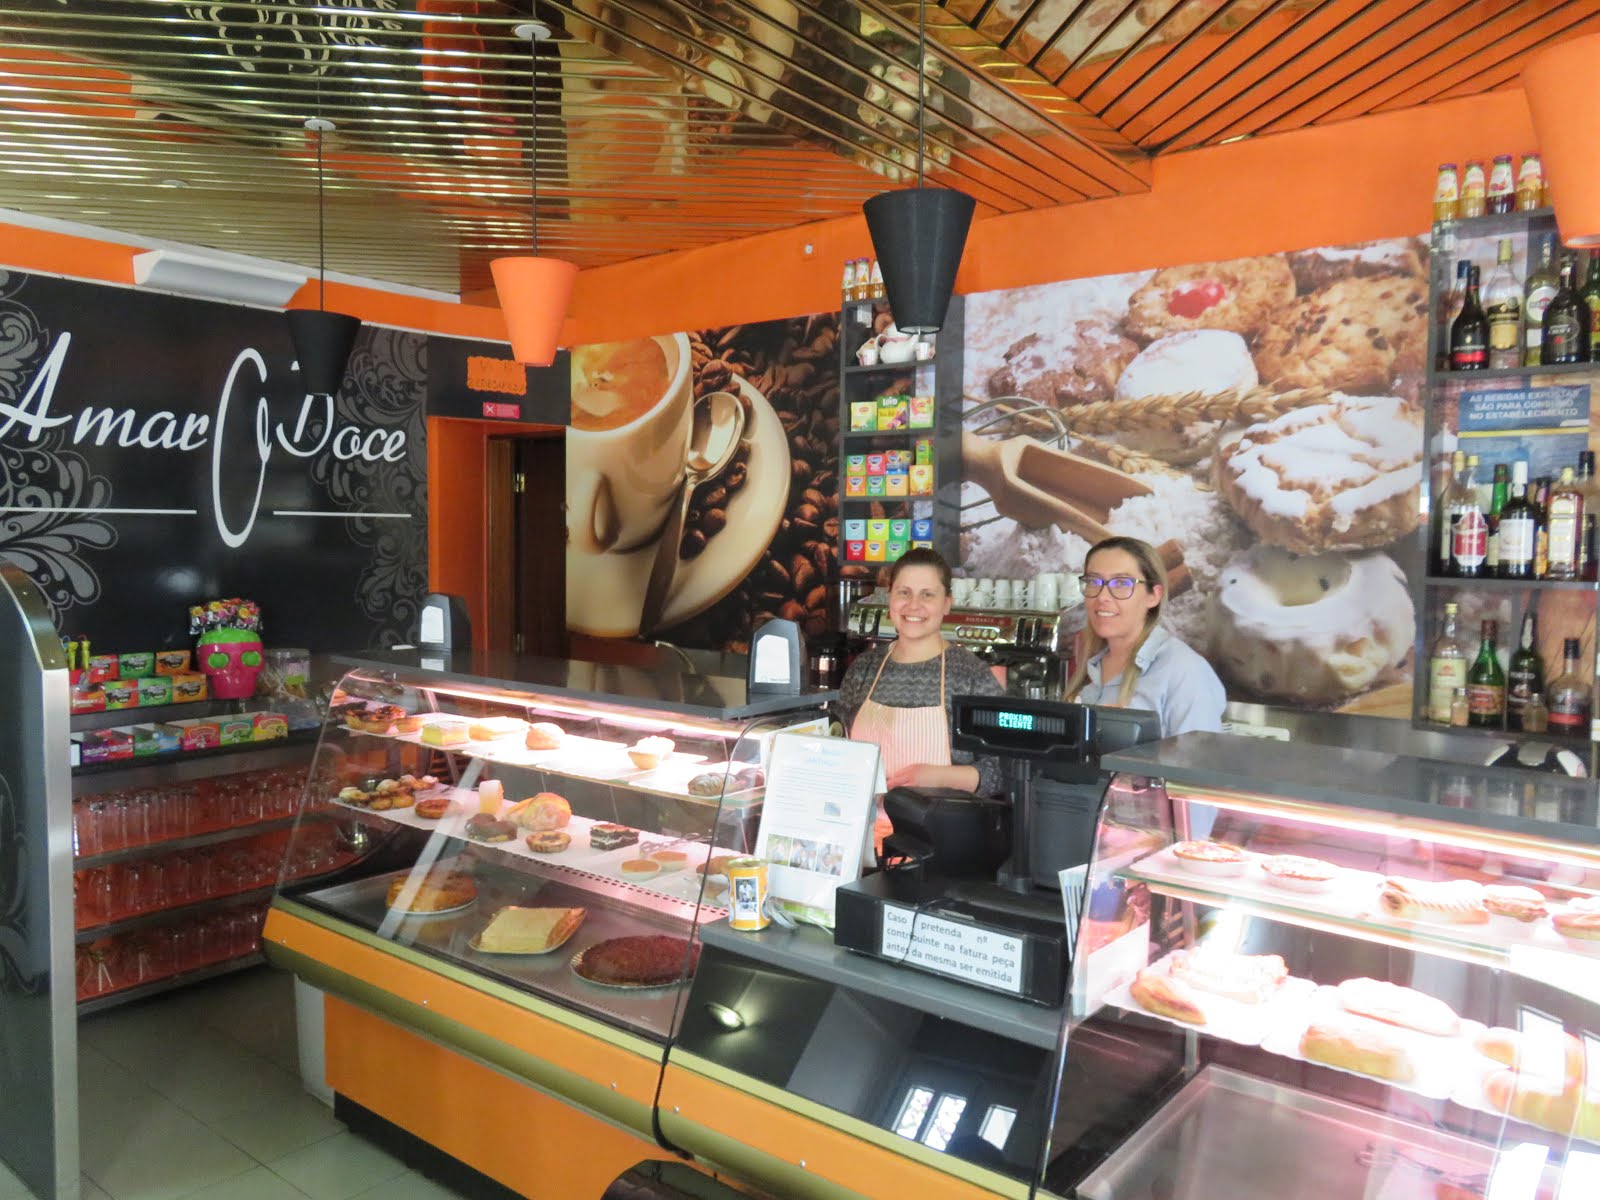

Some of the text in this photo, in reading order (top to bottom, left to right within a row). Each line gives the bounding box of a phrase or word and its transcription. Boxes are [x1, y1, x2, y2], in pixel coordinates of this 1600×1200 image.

[1485, 391, 1526, 402] BEBIDAS
[1496, 401, 1521, 410] PARA
[1469, 407, 1578, 420] NO ESTABELECIMENTO
[999, 711, 1033, 721] PROXIMO
[999, 719, 1033, 730] CLIENTE
[887, 911, 908, 924] Caso
[920, 920, 962, 938] pretenda
[1003, 940, 1016, 952] de
[943, 942, 956, 953] na
[959, 943, 988, 961] fatura
[992, 954, 1015, 968] peça
[911, 947, 923, 958] da
[924, 952, 957, 968] mesma
[959, 960, 973, 973] ser
[975, 964, 1013, 983] emitida
